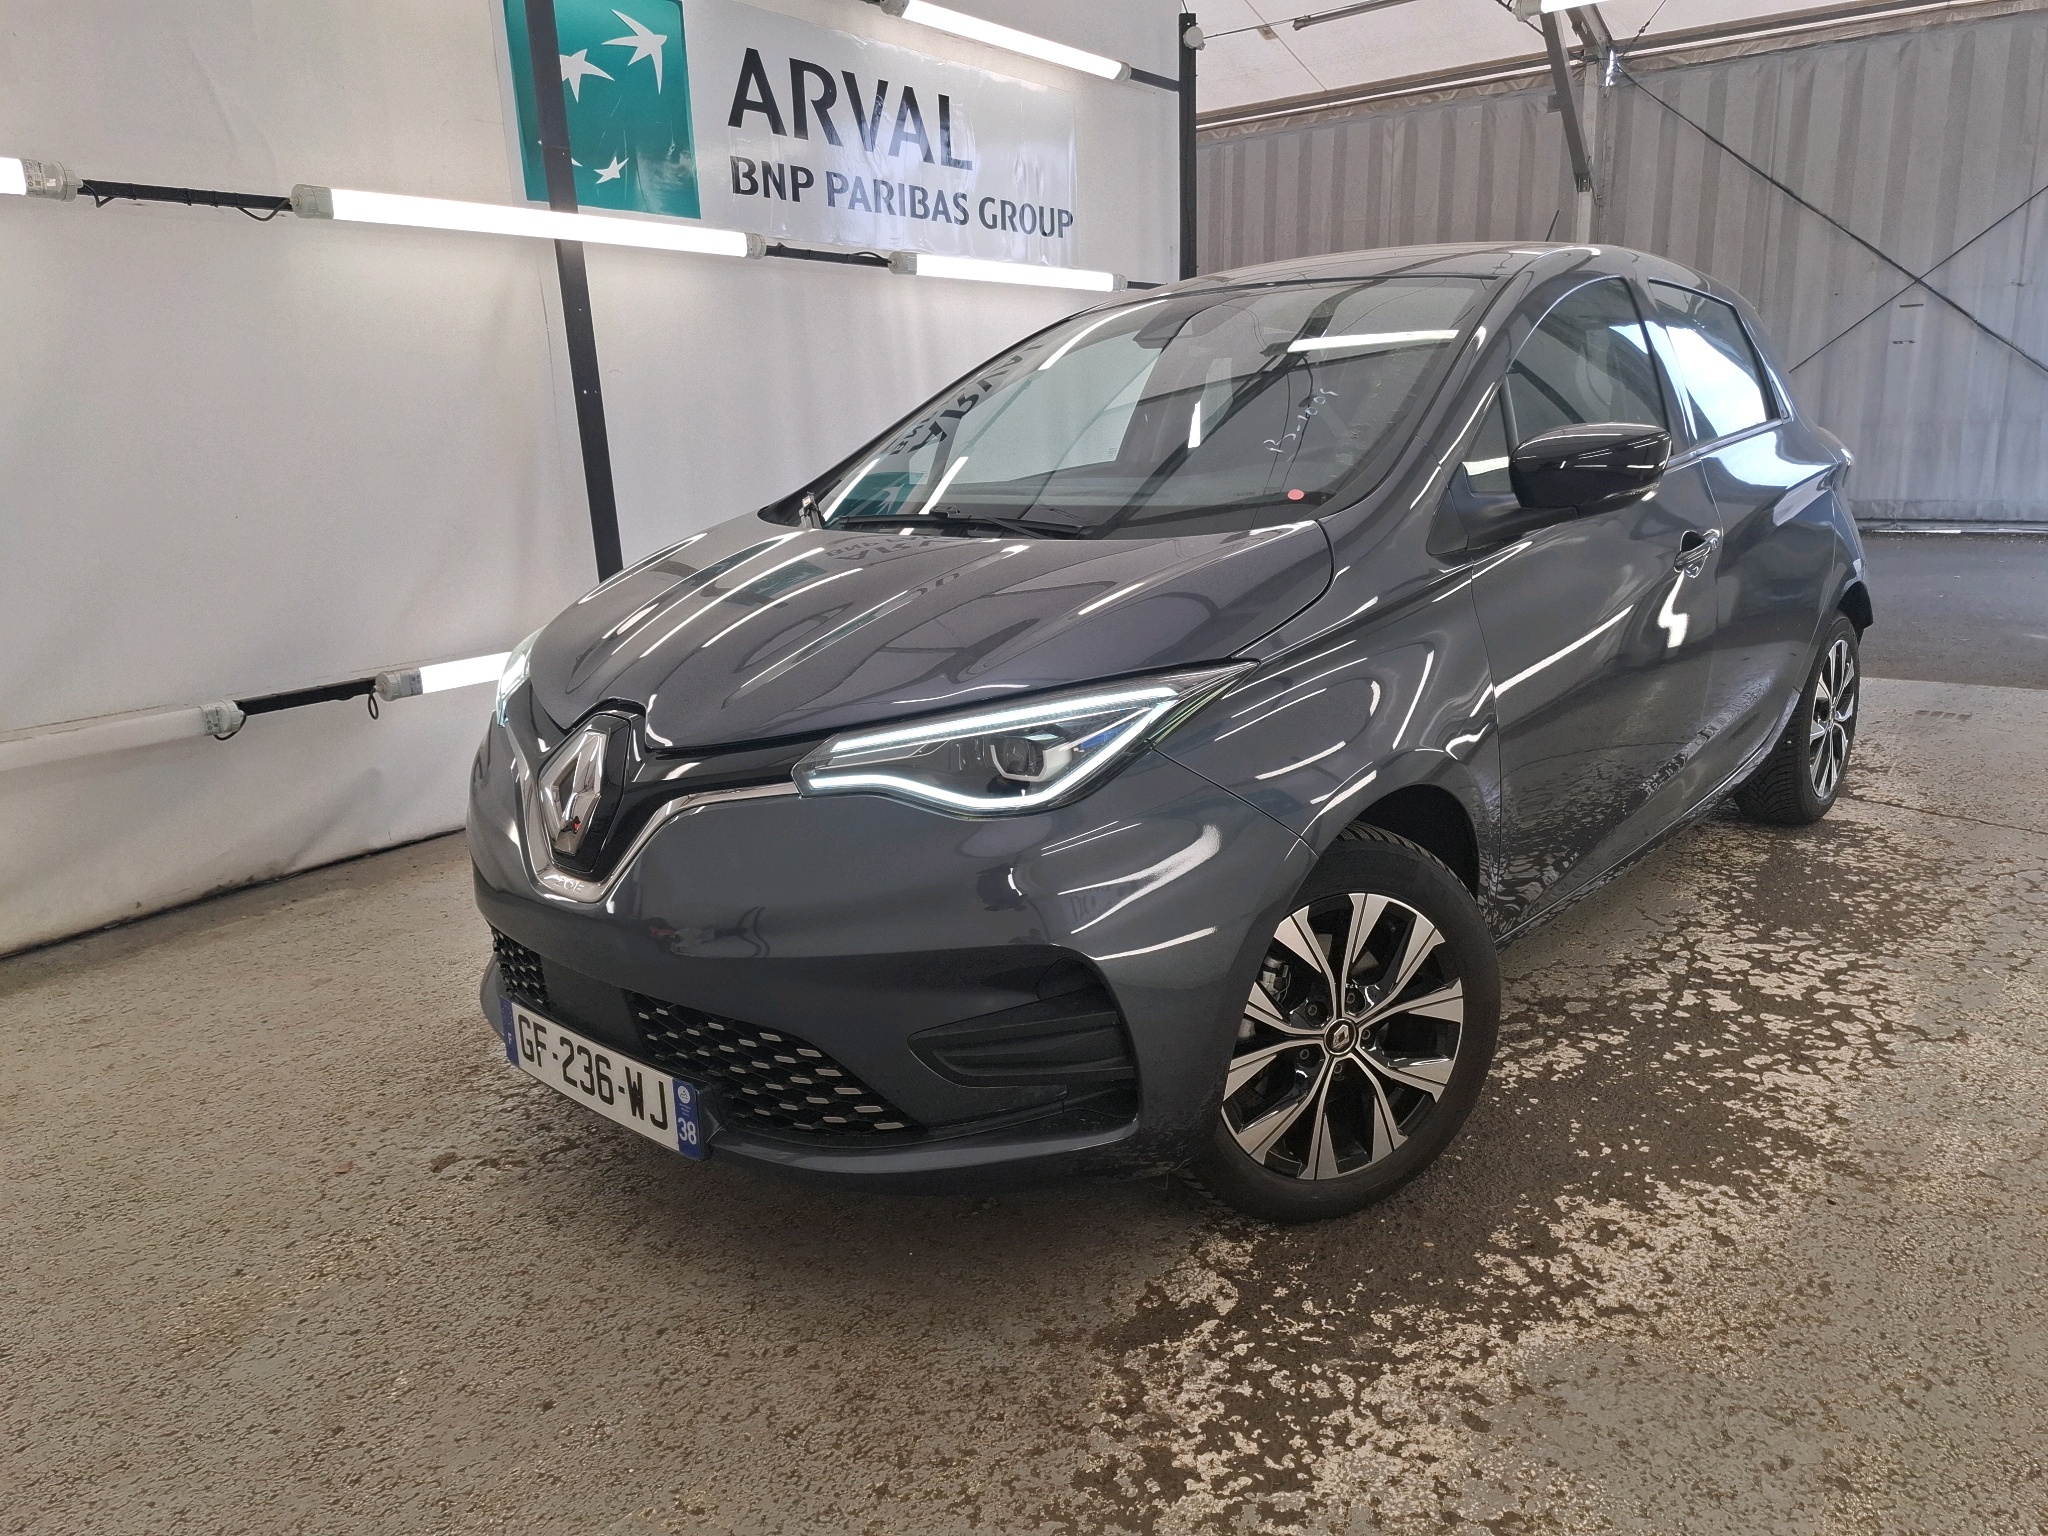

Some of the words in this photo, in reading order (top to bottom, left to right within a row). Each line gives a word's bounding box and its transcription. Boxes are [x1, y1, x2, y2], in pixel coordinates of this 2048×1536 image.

[728, 47, 973, 171] ARVAL
[730, 155, 815, 203] BNP
[826, 170, 969, 226] PARIBAS
[978, 196, 1074, 239] GROUP
[518, 1014, 669, 1131] GF-236-WJ
[677, 1117, 697, 1145] 38
